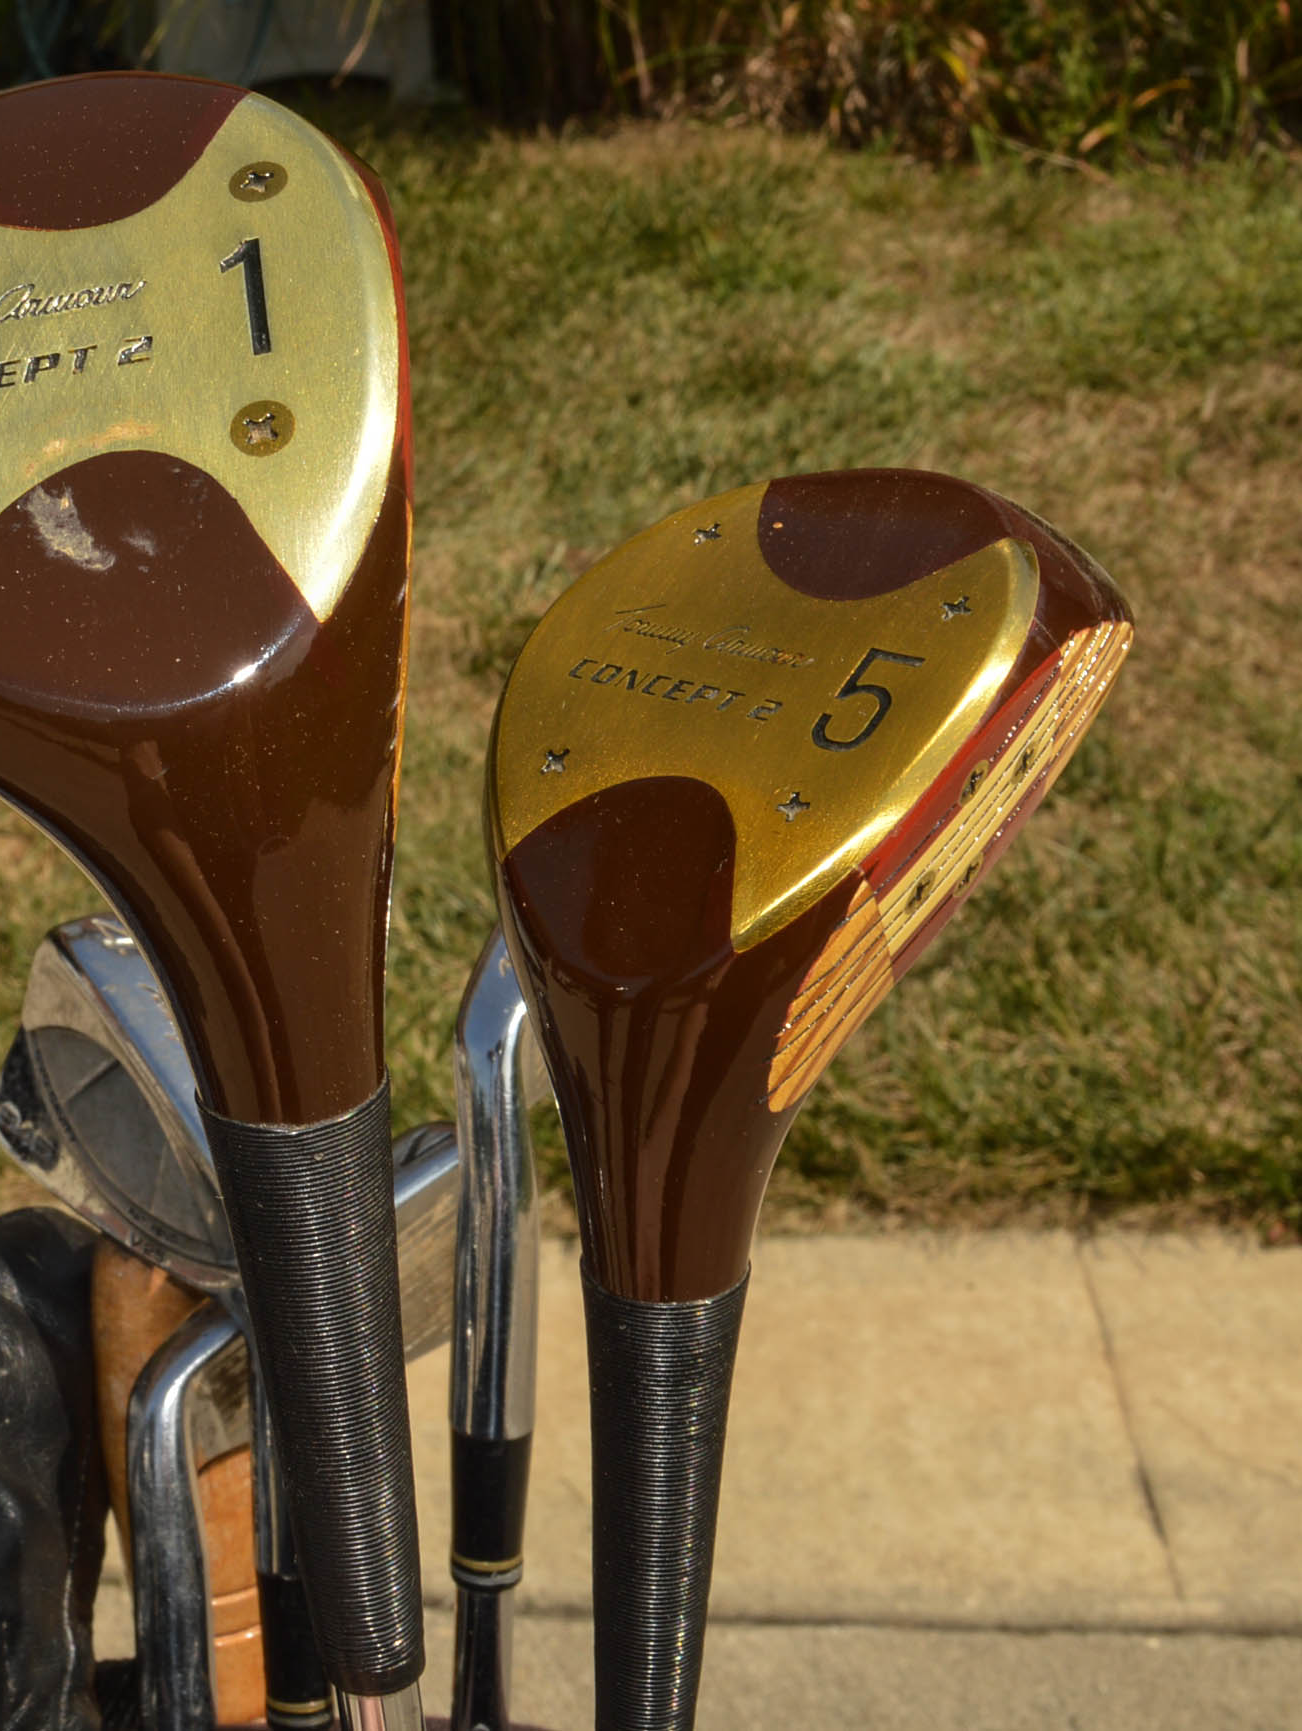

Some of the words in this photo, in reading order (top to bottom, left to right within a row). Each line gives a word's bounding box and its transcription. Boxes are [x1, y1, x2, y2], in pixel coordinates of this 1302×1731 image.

[220, 237, 272, 355] 1
[117, 335, 153, 366] 2
[603, 604, 699, 655] Tommy
[568, 657, 746, 712] CONCEPT
[746, 698, 784, 722] 2
[811, 647, 926, 753] 5
